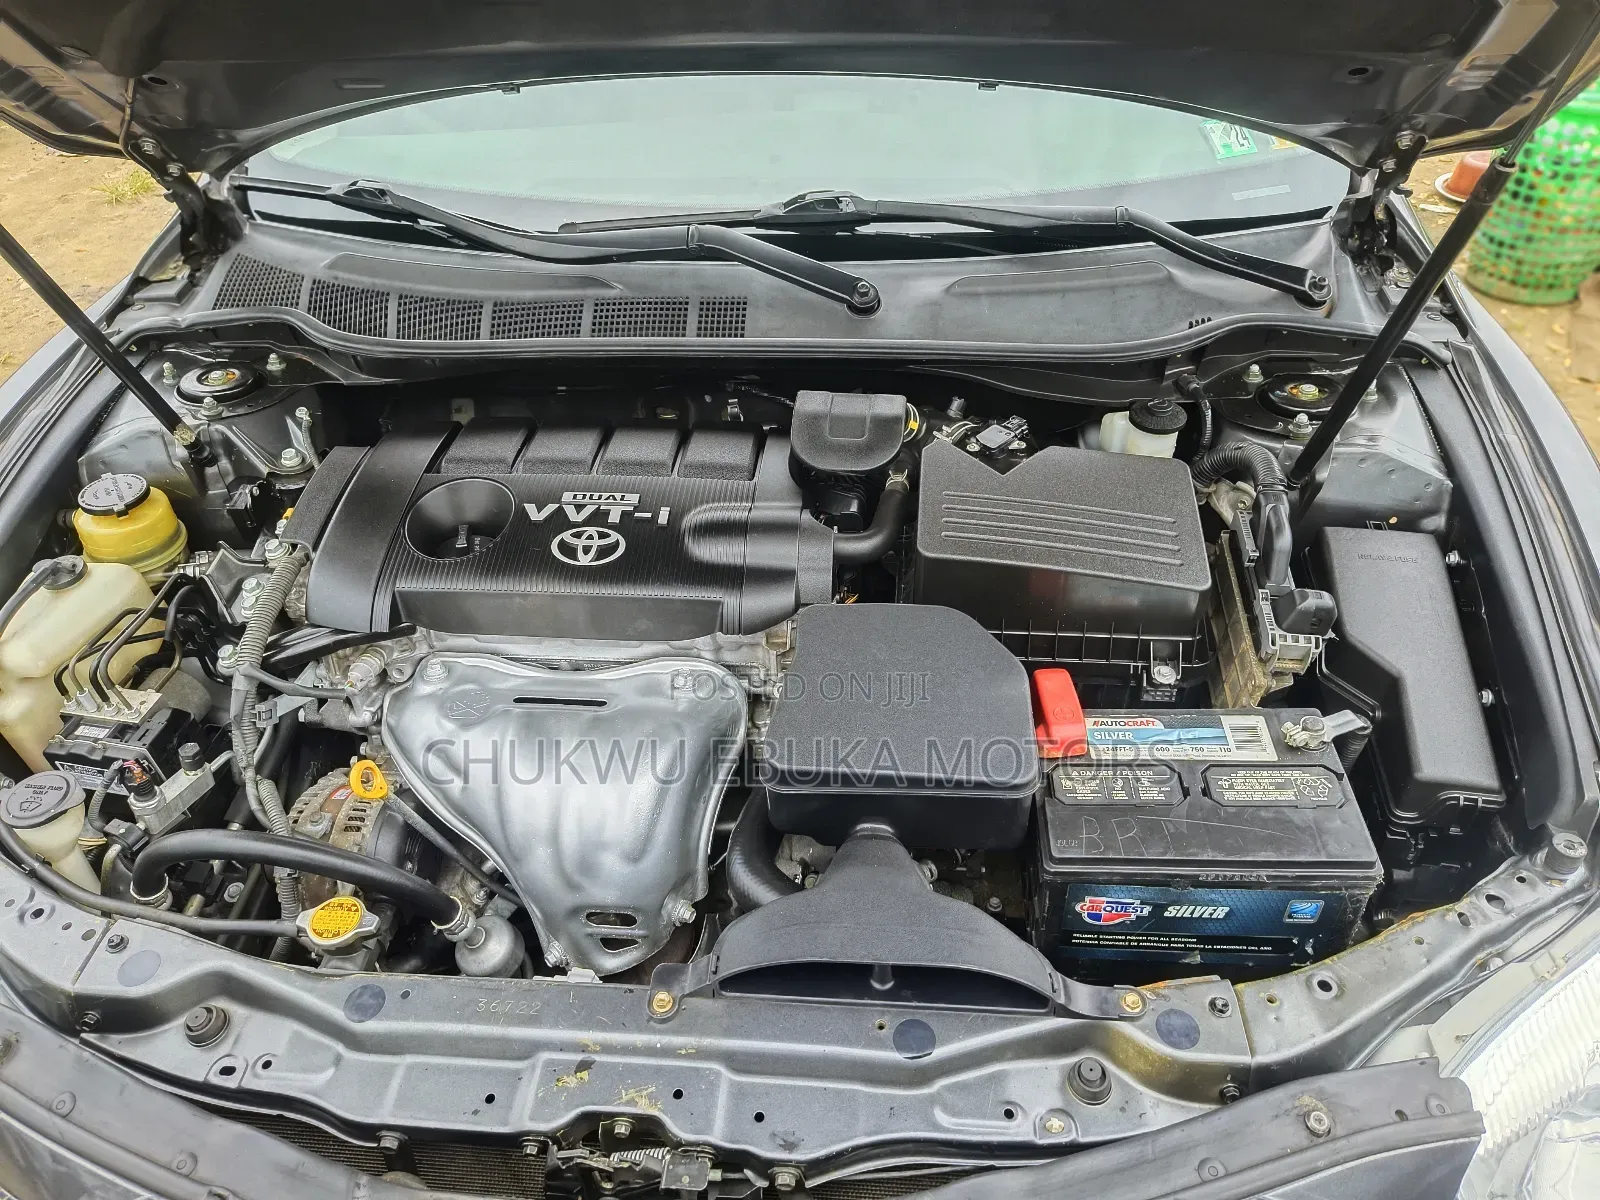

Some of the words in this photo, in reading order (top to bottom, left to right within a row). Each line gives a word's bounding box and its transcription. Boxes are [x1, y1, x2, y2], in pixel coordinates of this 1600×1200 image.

[572, 493, 632, 501] DUAL
[523, 503, 671, 526] VVT-i
[1394, 555, 1418, 564] FUSE
[1099, 719, 1156, 728] AUTOCRAFT
[1093, 731, 1134, 740] SILVER
[1079, 903, 1147, 914] CARQUEST
[1163, 905, 1231, 919] SILVER
[476, 998, 542, 1015] 36722
